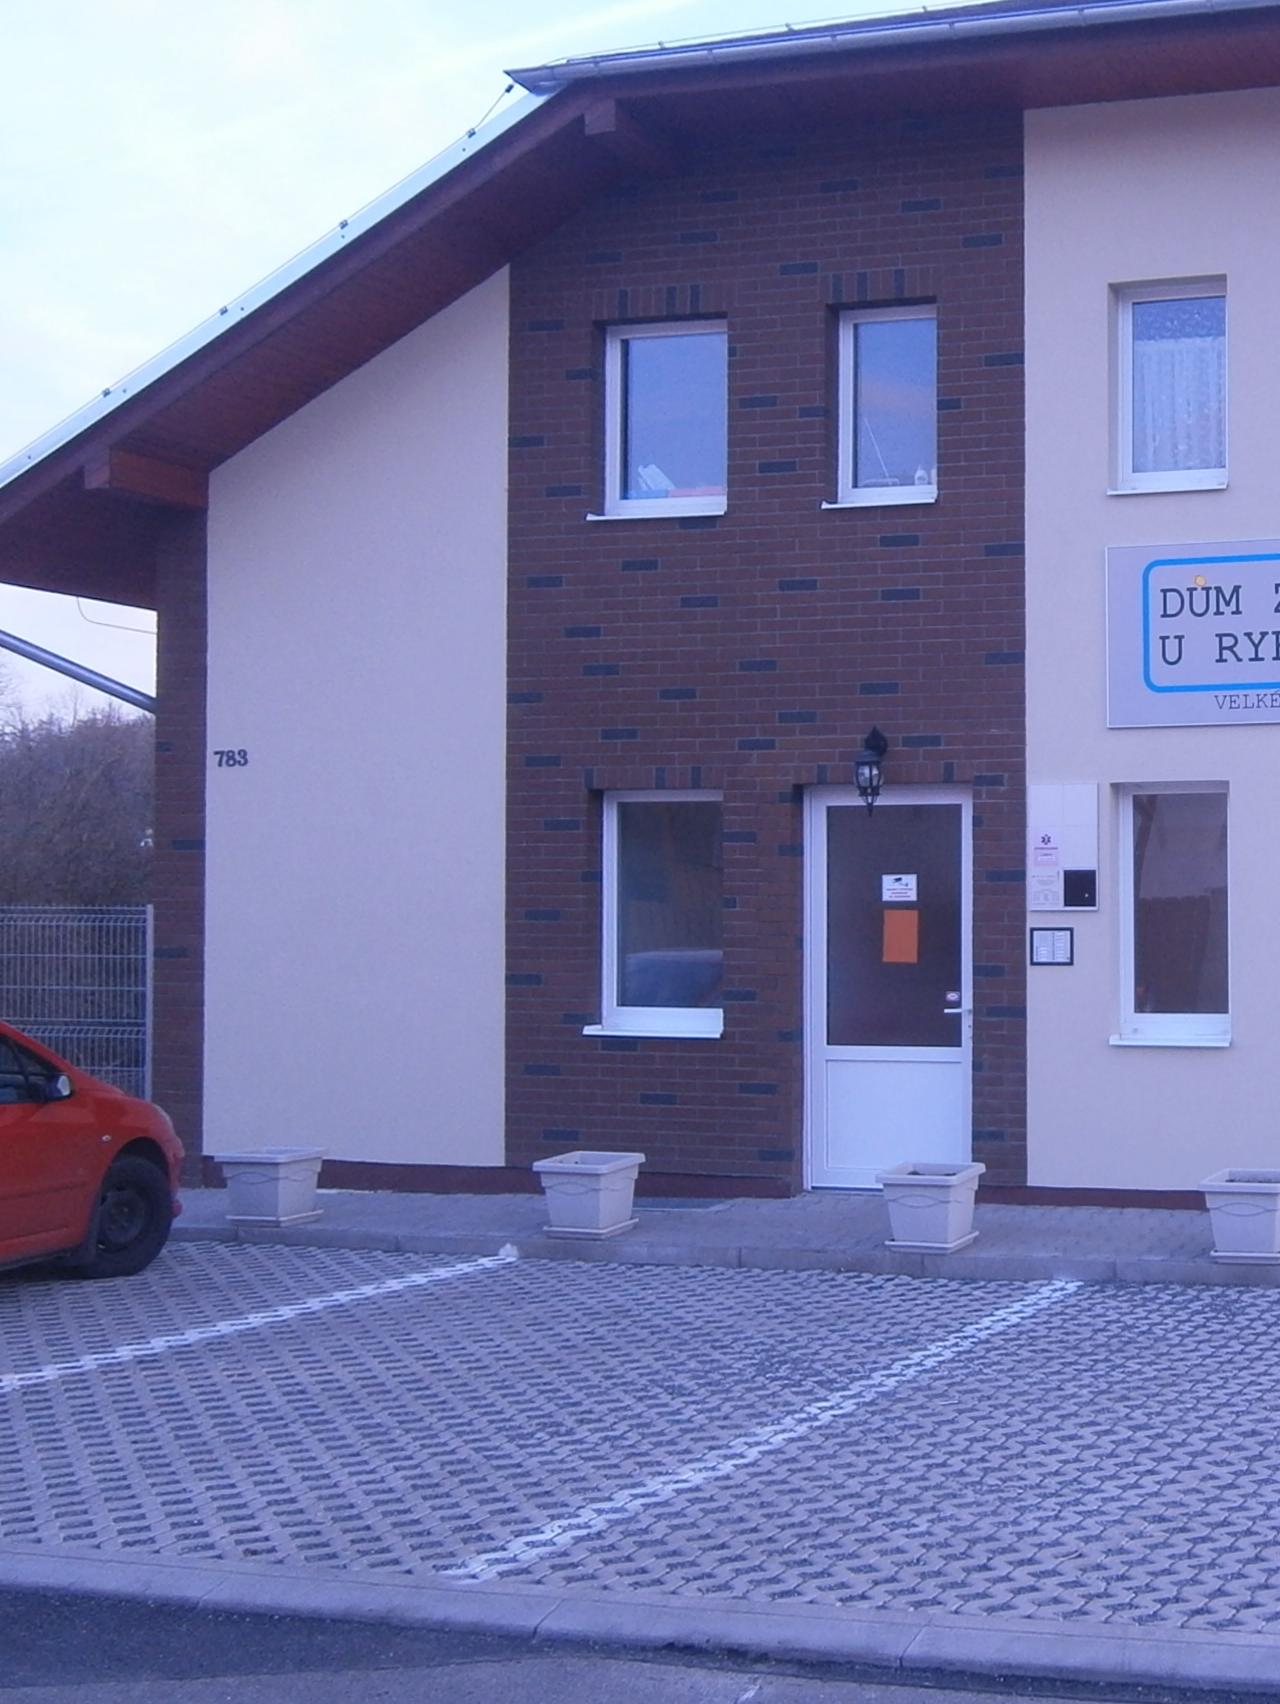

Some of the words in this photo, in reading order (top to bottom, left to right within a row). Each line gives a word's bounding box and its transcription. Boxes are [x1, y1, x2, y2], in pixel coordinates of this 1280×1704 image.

[1160, 575, 1242, 618] DŮM
[1159, 635, 1185, 666] U
[213, 749, 248, 767] 783
